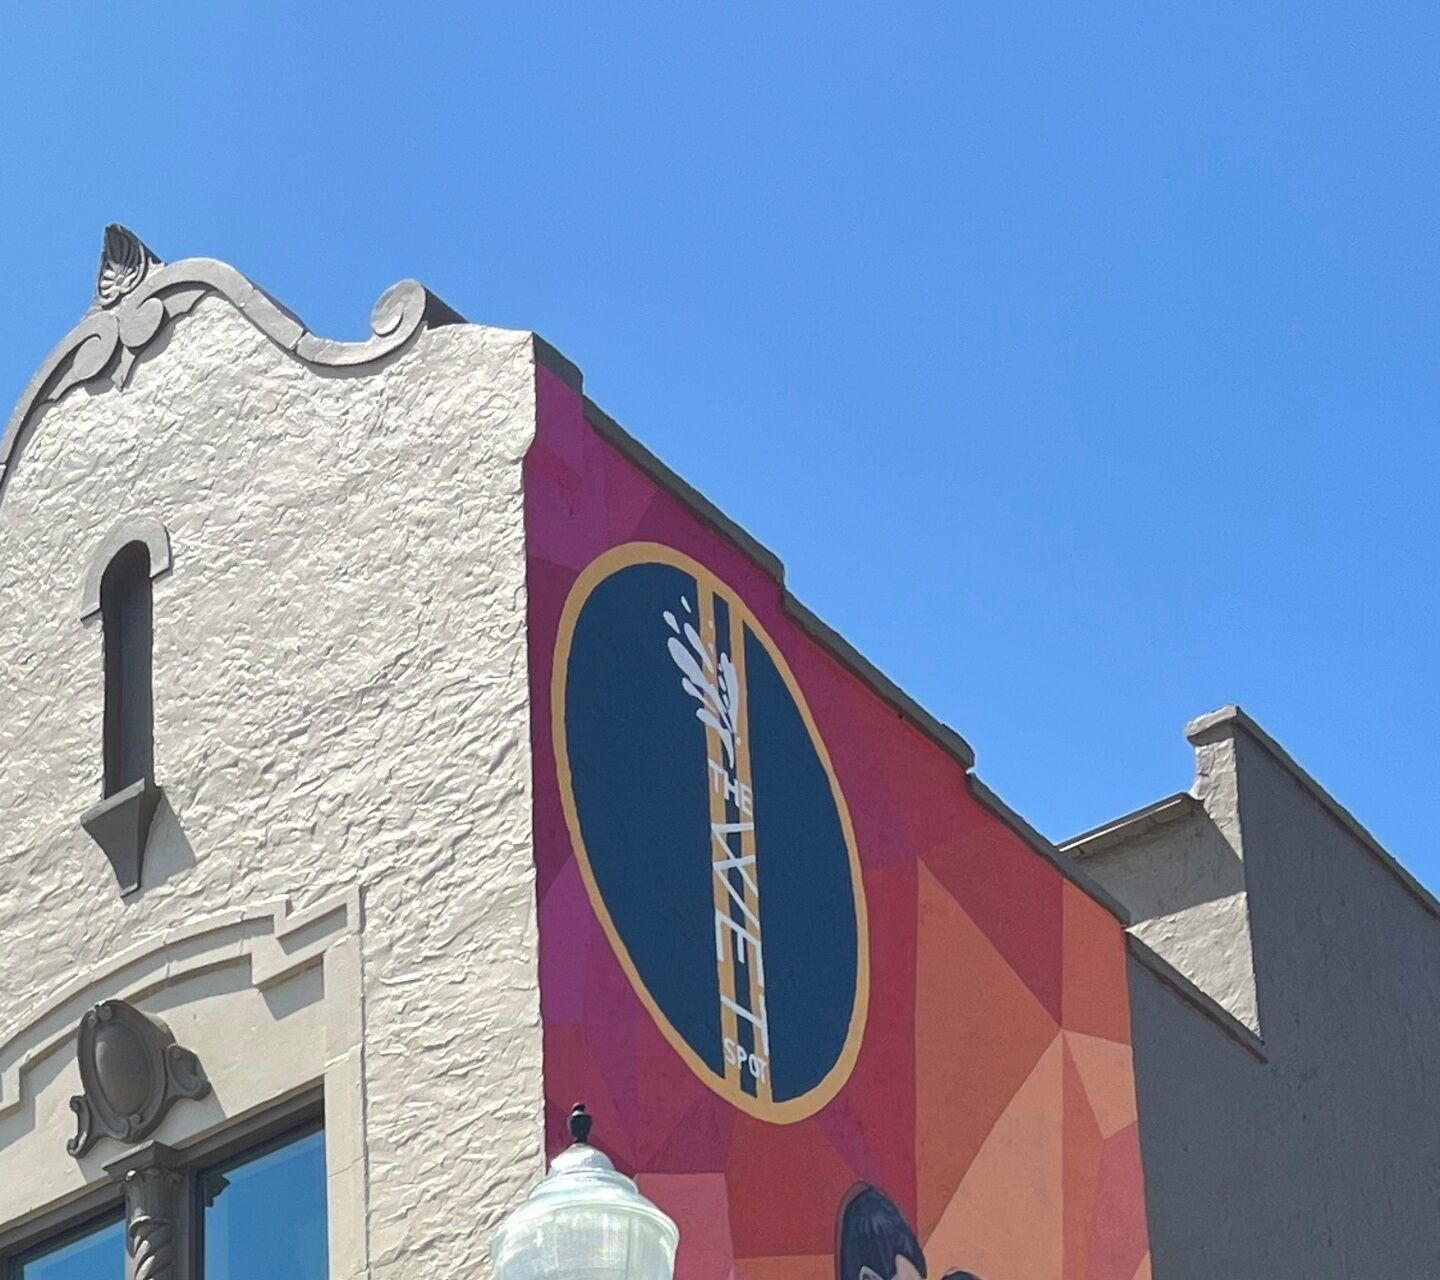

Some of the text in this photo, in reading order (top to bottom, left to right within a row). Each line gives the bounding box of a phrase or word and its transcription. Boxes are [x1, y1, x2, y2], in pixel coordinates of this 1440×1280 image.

[707, 757, 753, 817] THE
[710, 820, 770, 1057] WET
[722, 1037, 770, 1085] SPOT
